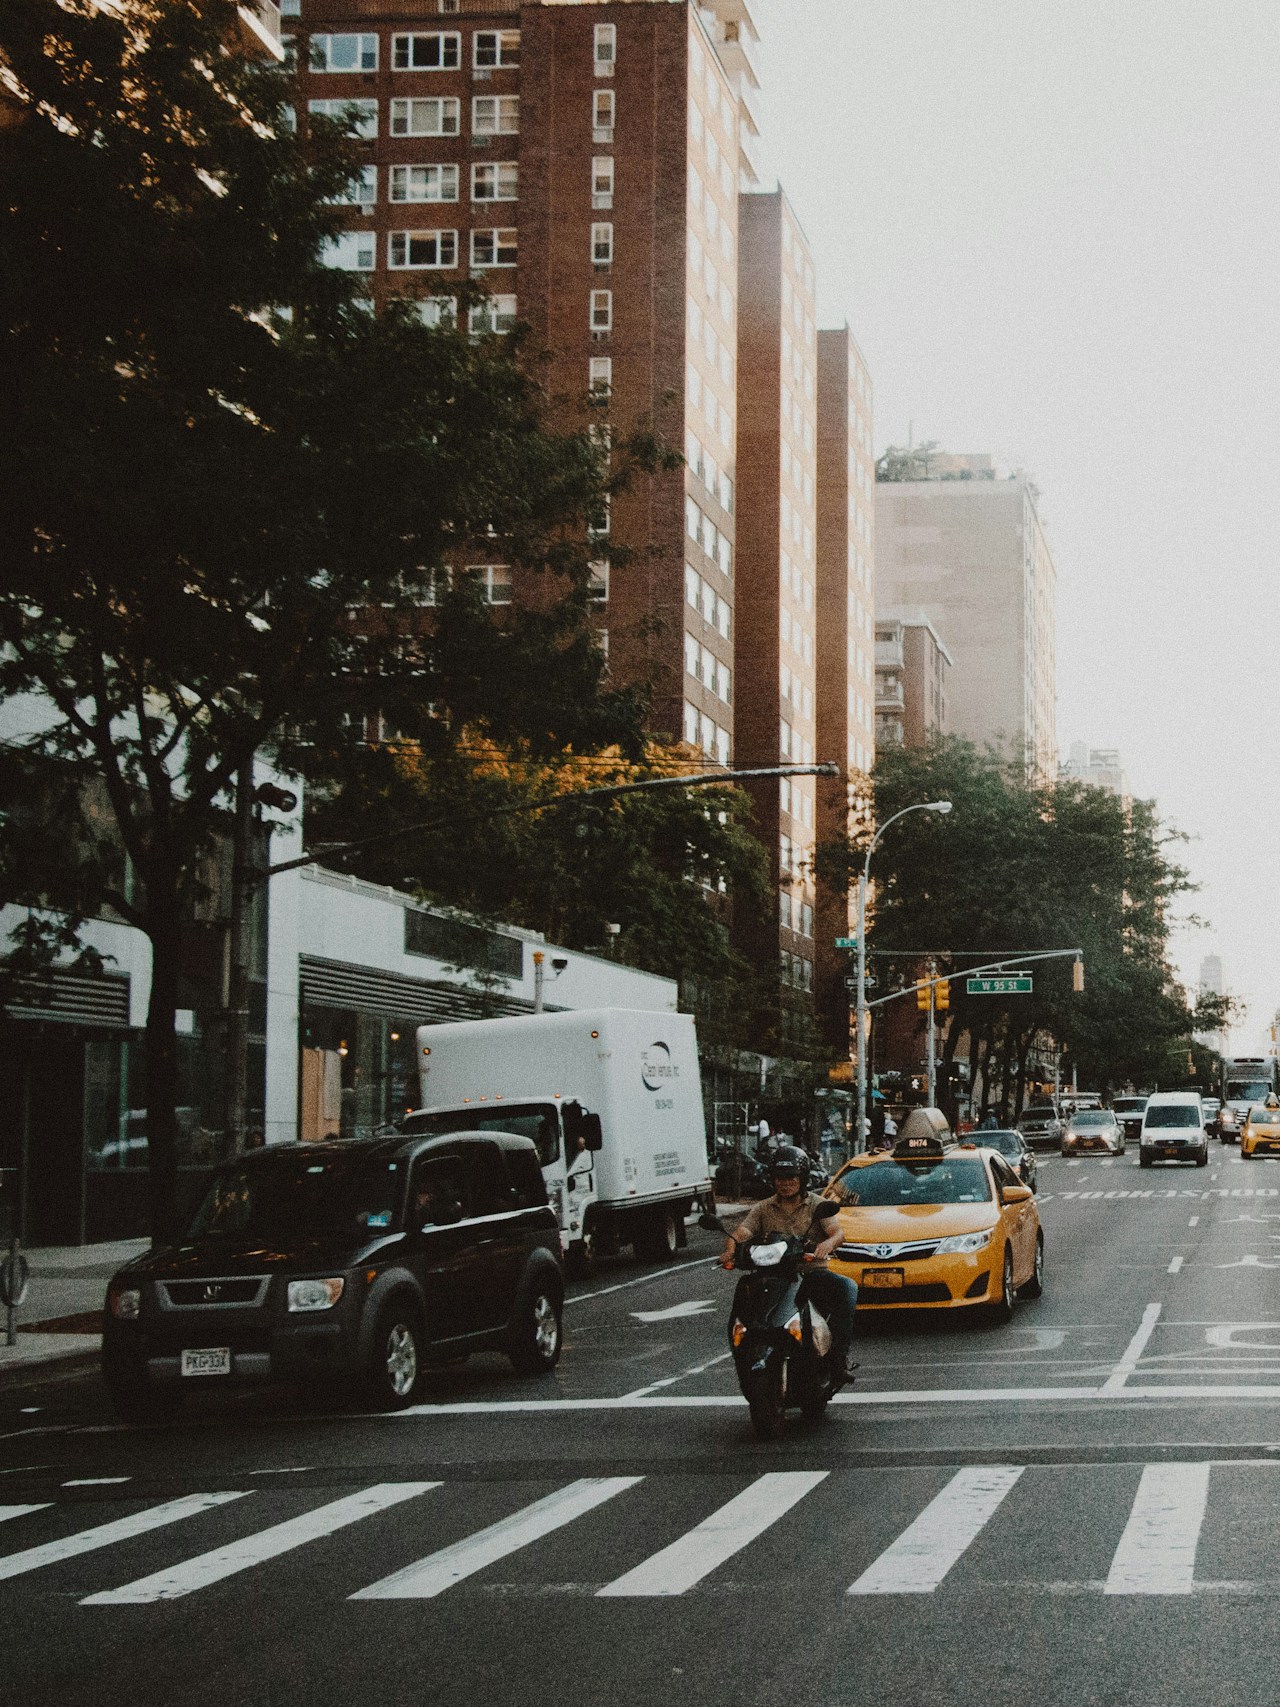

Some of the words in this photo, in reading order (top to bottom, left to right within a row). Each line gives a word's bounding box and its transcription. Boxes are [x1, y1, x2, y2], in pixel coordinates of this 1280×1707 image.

[982, 982, 991, 990] W
[993, 982, 1004, 990] 95
[1008, 981, 1017, 990] St
[908, 1138, 928, 1148] 8H74
